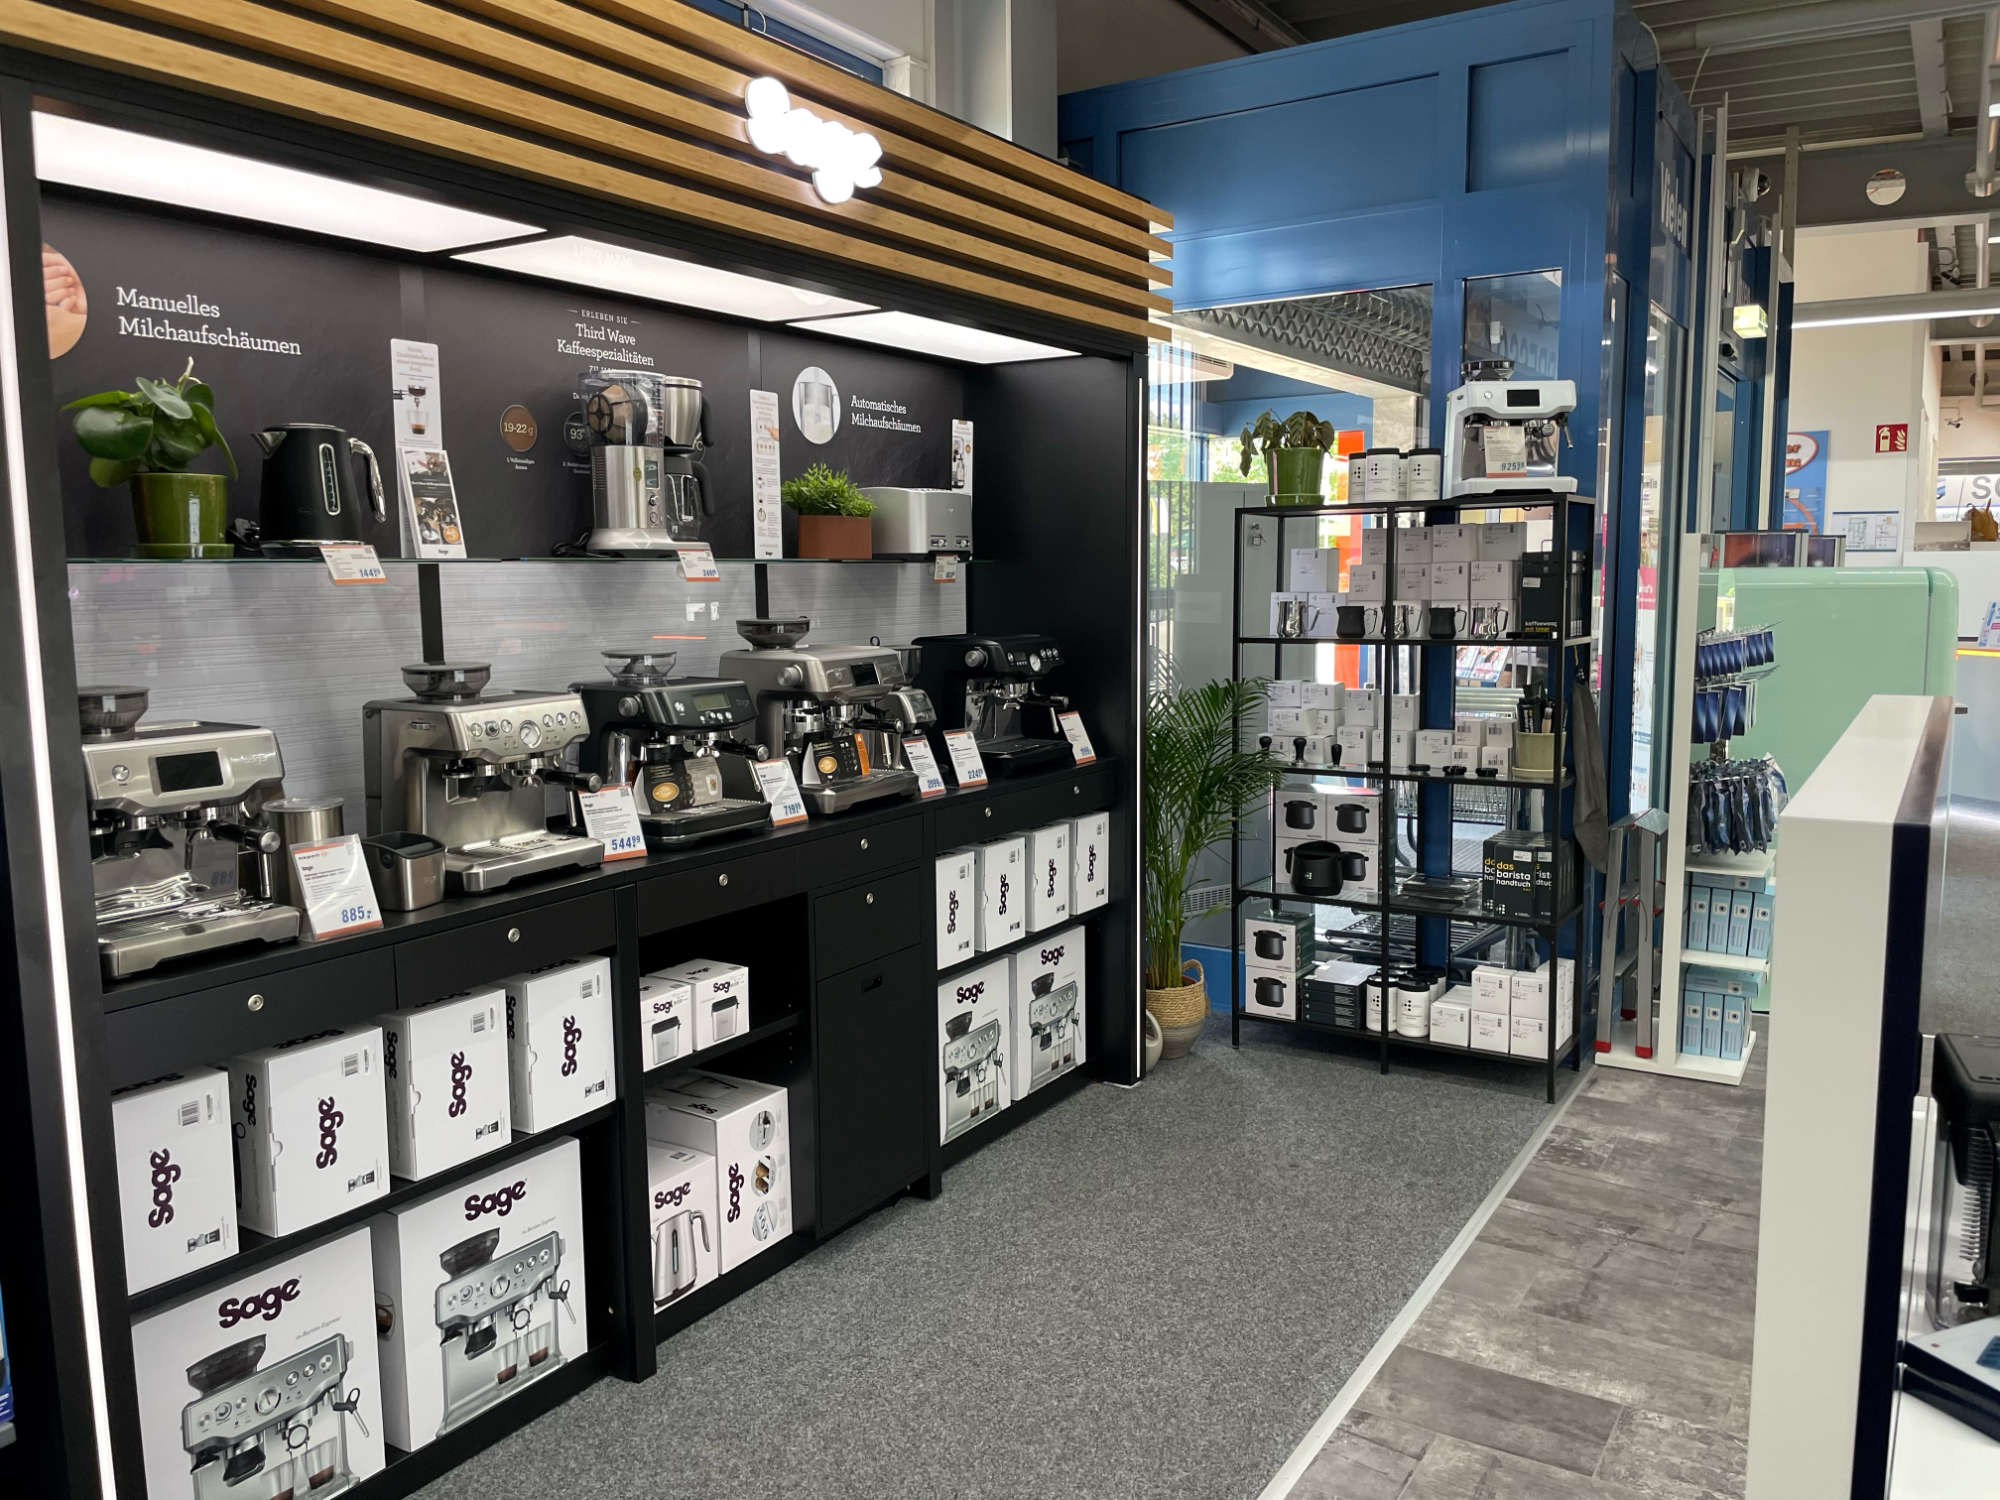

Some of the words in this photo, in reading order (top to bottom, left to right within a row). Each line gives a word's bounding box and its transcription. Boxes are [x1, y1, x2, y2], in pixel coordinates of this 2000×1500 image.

[1661, 161, 1688, 249] Vielen
[116, 287, 221, 318] Manuelles
[581, 309, 614, 322] ERLEBEN
[616, 315, 628, 325] SIE
[118, 316, 302, 356] Milchaufschäumen
[575, 323, 606, 341] Third
[606, 328, 636, 346] Wave
[557, 338, 655, 367] Kaffeespezialitäten
[850, 395, 907, 414] Automatisches
[504, 422, 527, 434] 19-22
[851, 412, 922, 433] Milchaufschäumen
[1496, 861, 1514, 870] das
[1496, 869, 1531, 880] barista
[1496, 879, 1531, 888] handtuch
[712, 981, 730, 994] Sag
